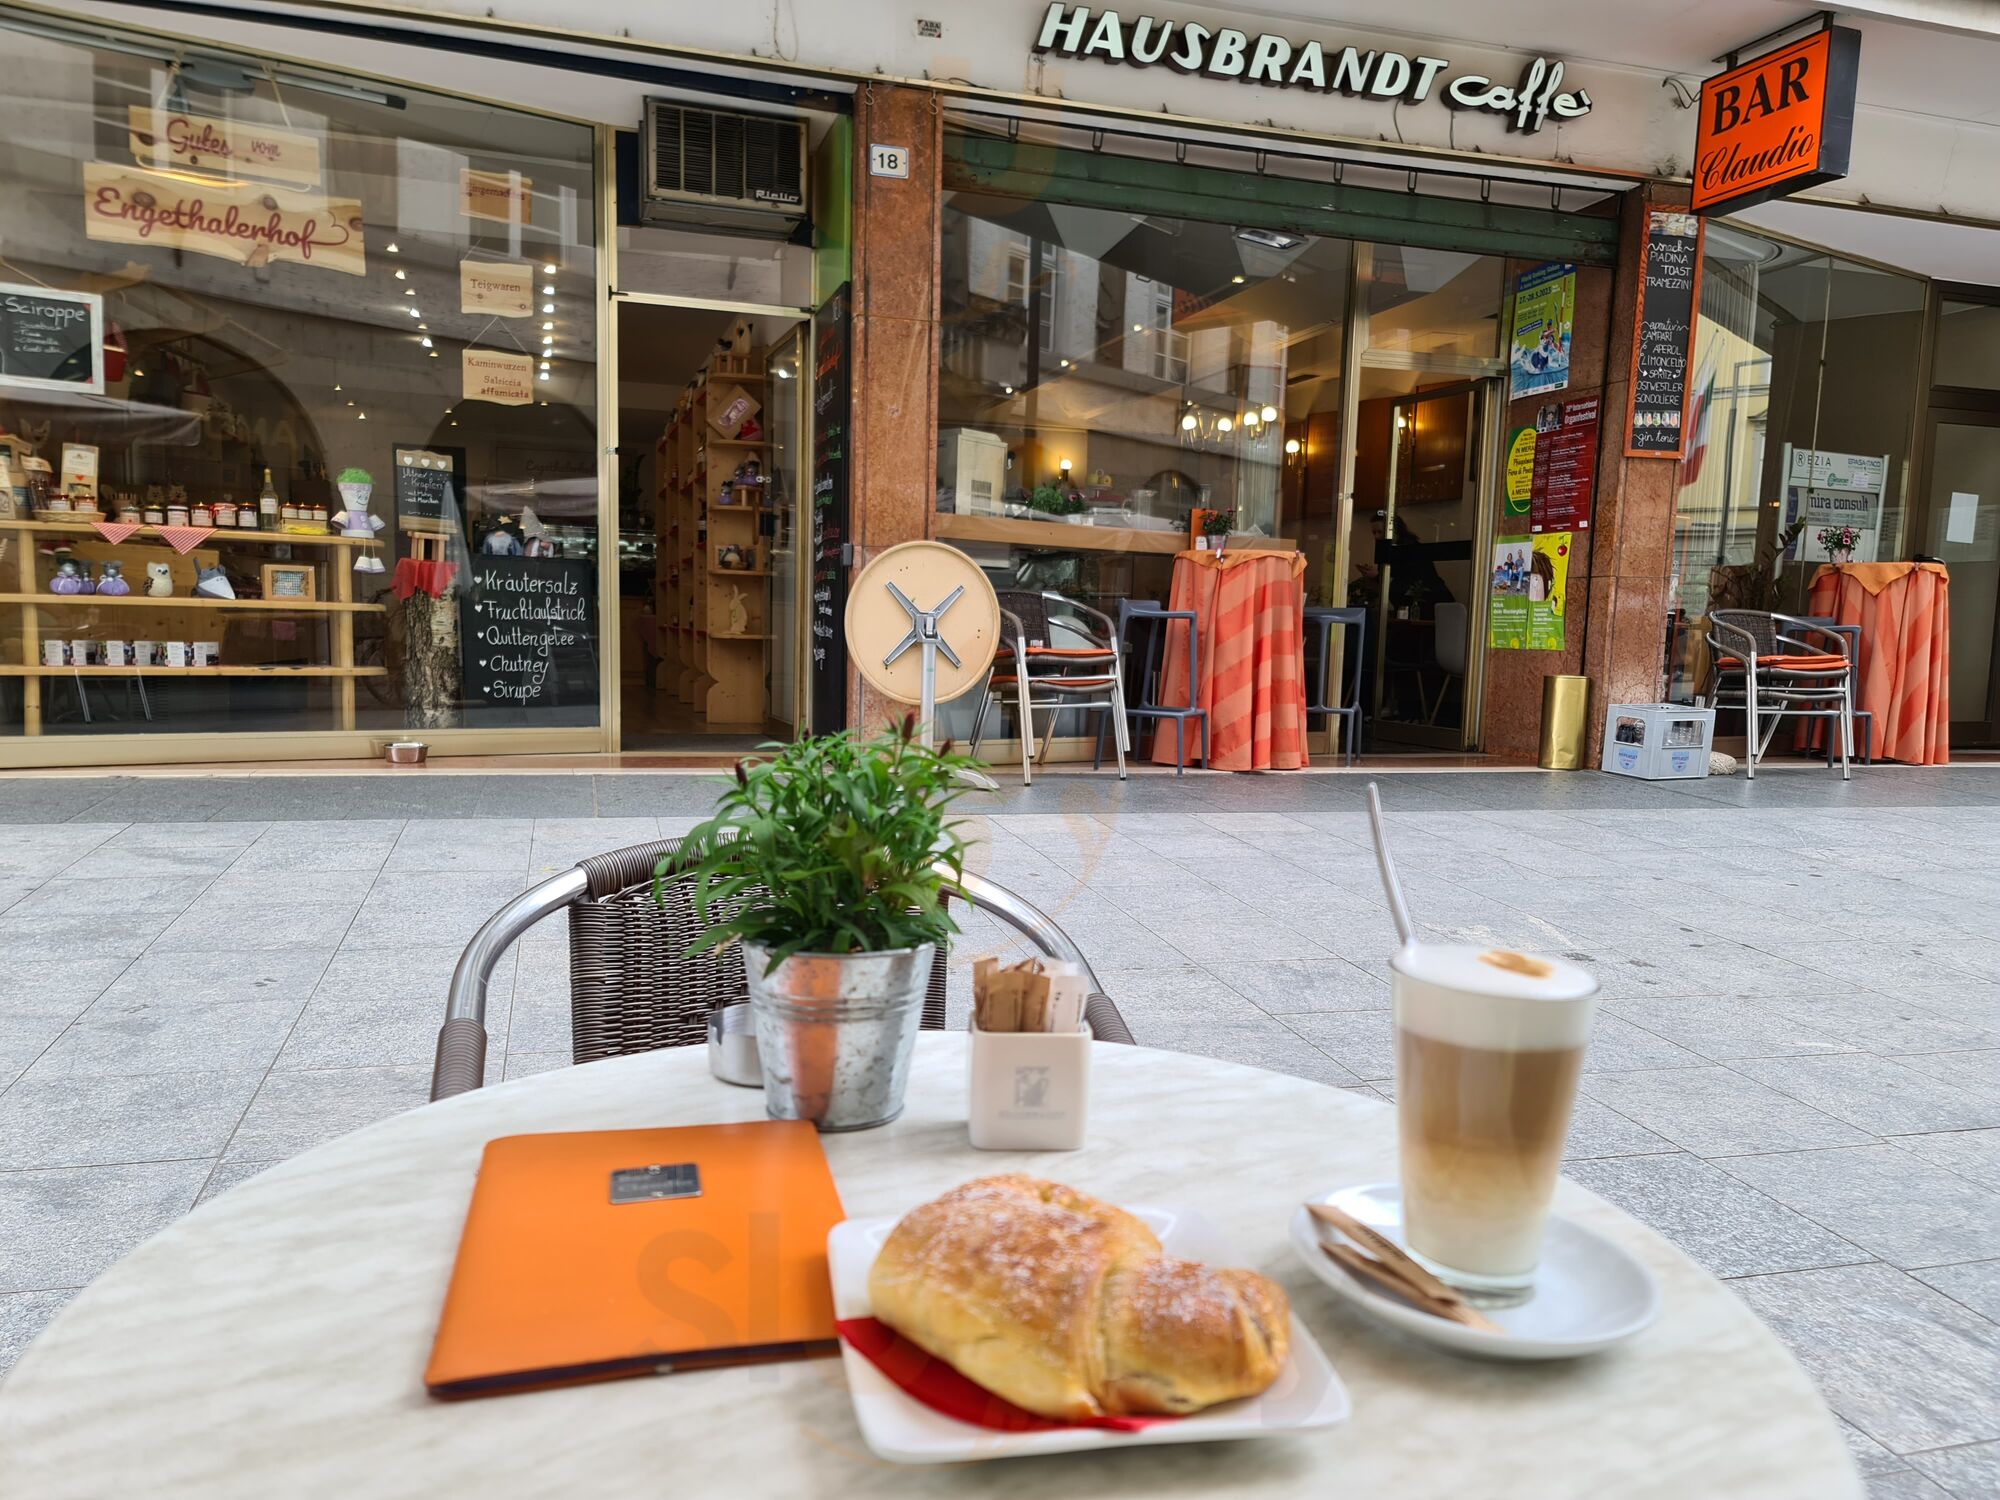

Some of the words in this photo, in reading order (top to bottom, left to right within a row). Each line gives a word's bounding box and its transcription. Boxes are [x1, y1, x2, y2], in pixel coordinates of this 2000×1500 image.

[1038, 2, 1450, 98] HAUSBRANDT
[1711, 56, 1810, 137] BAR
[166, 119, 233, 158] Gutes
[251, 139, 282, 158] vom
[878, 153, 899, 169] 18
[1700, 124, 1815, 191] Claudio
[755, 189, 800, 203] Riello
[94, 187, 350, 260] Engethalerhof
[1650, 251, 1689, 264] PIADINA
[1661, 264, 1692, 276] TOAST
[470, 278, 521, 292] Teigwaren
[5, 296, 86, 329] Sciroppe
[1640, 330, 1673, 342] CAMPARI
[1652, 344, 1682, 356] APEROL
[467, 358, 527, 372] Kaminwurzen
[481, 387, 530, 399] affumicata
[1655, 429, 1676, 444] tonic
[1833, 496, 1869, 512] consult
[485, 569, 579, 595] Kräutersalz
[482, 597, 586, 626] Fruchtaufstrich
[486, 625, 575, 657] Quittengelee
[490, 653, 550, 685] Chutney
[493, 679, 542, 706] Sirupe
